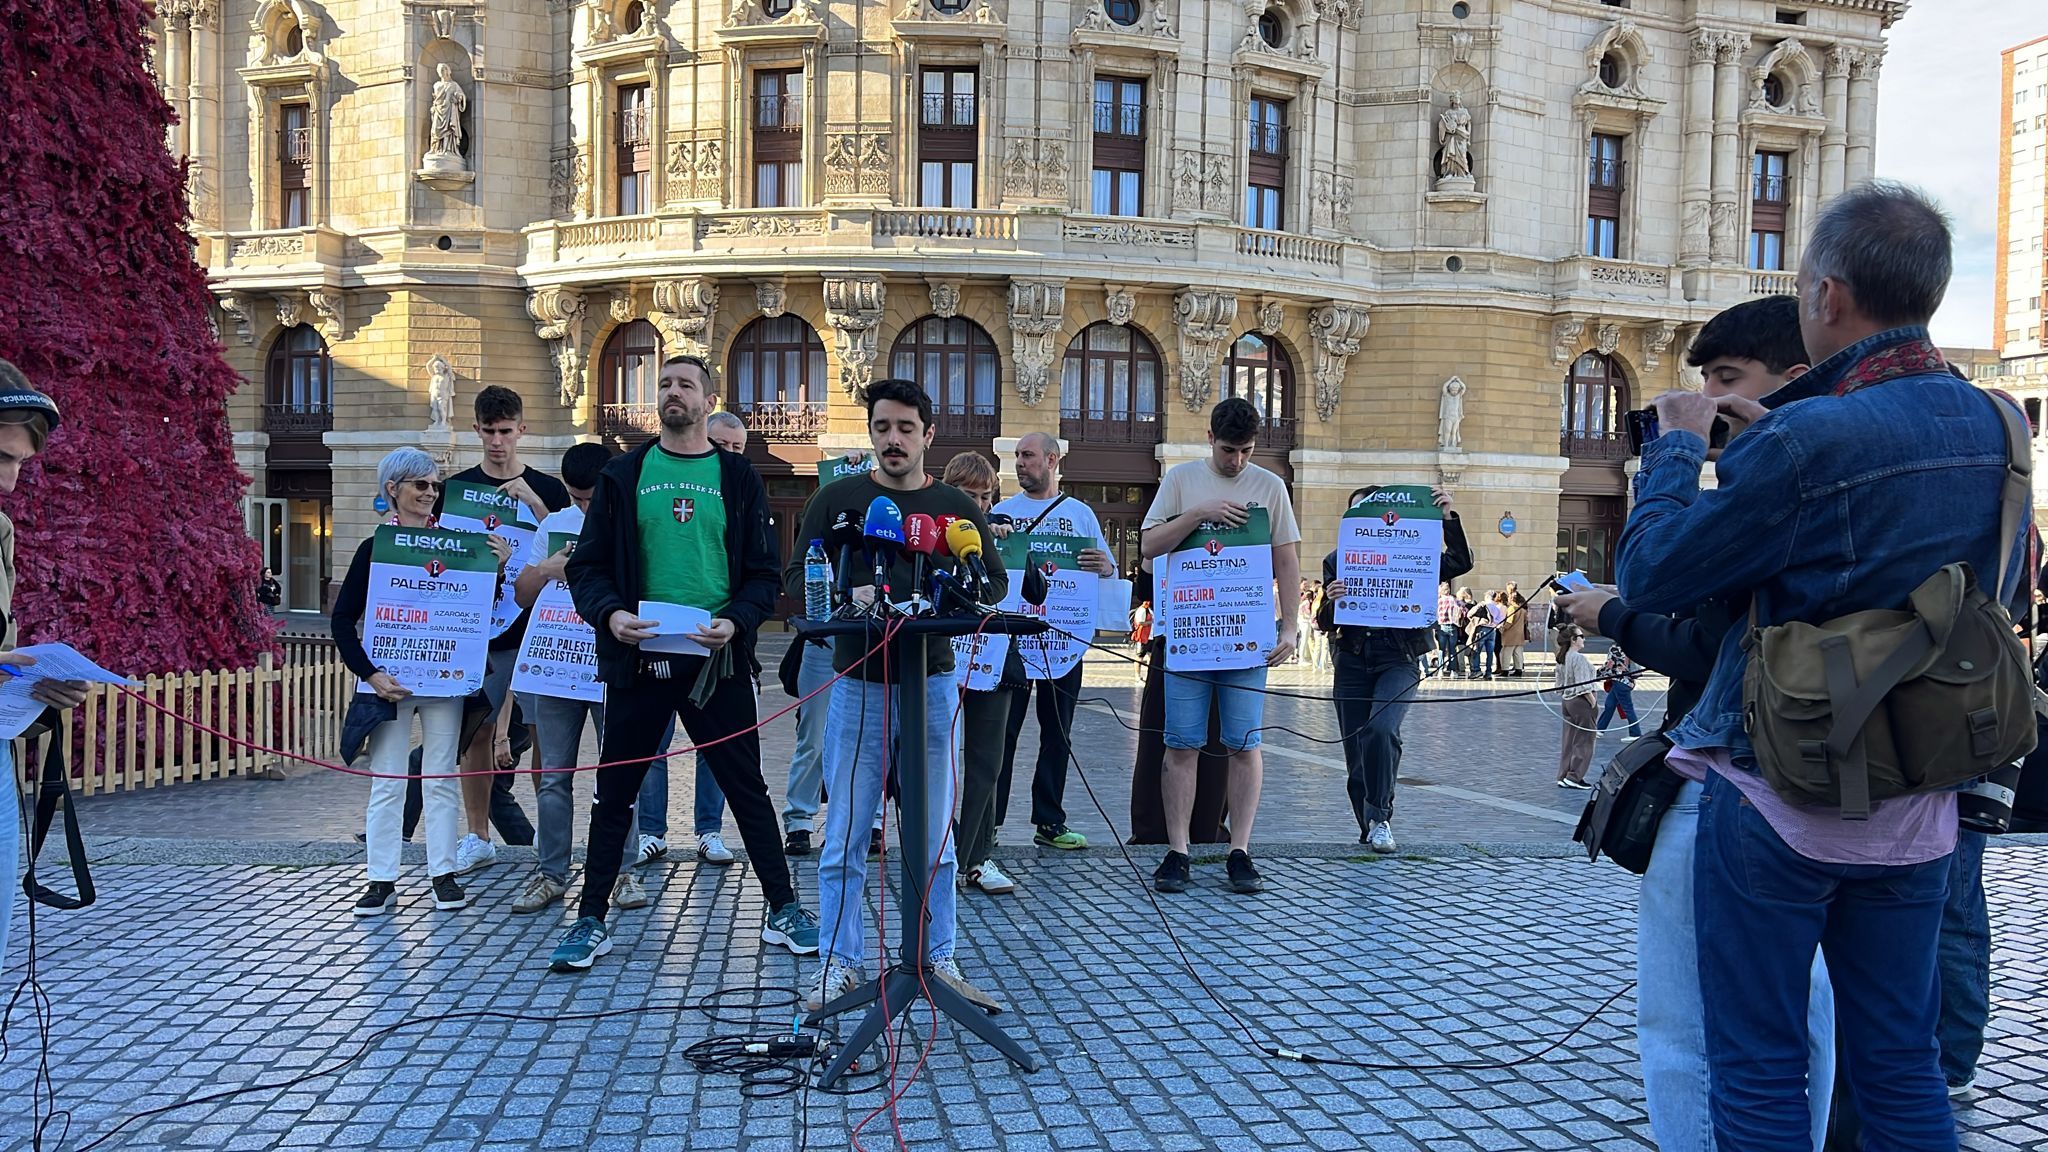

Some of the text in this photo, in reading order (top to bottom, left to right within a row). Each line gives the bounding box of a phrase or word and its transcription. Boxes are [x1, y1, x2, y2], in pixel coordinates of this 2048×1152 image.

[833, 460, 873, 477] EUSKA
[640, 482, 723, 499] EUSKAL SELEKZIO
[1367, 492, 1416, 504] USKAL
[959, 523, 977, 531] SE
[1059, 517, 1073, 532] 82
[875, 529, 897, 539] etb
[1355, 528, 1419, 539] PALESTINA
[394, 533, 468, 553] EUSKAL
[1030, 541, 1072, 555] SKAL
[1181, 558, 1247, 571] PALESTINA
[1345, 553, 1388, 566] KALEJIRA
[390, 577, 468, 592] PALESTINA
[1046, 579, 1076, 590] STINA
[1344, 577, 1414, 590] GORA PALESTINAR
[1173, 588, 1215, 603] KALEJIRA
[375, 607, 428, 624] KALEJIRA
[434, 610, 470, 618] AZAROAK
[1173, 614, 1246, 628] GORA PALESTINAR
[1173, 626, 1243, 639] ERRESISTENTZIA!
[373, 635, 457, 651] GORA PALESTINAR
[530, 635, 596, 654] GORA PALESTI
[1018, 639, 1069, 651] ESISTENTZIA!
[371, 647, 451, 663] ERRESISTENTZIA!
[527, 646, 598, 667] ERRESISTENTZI
